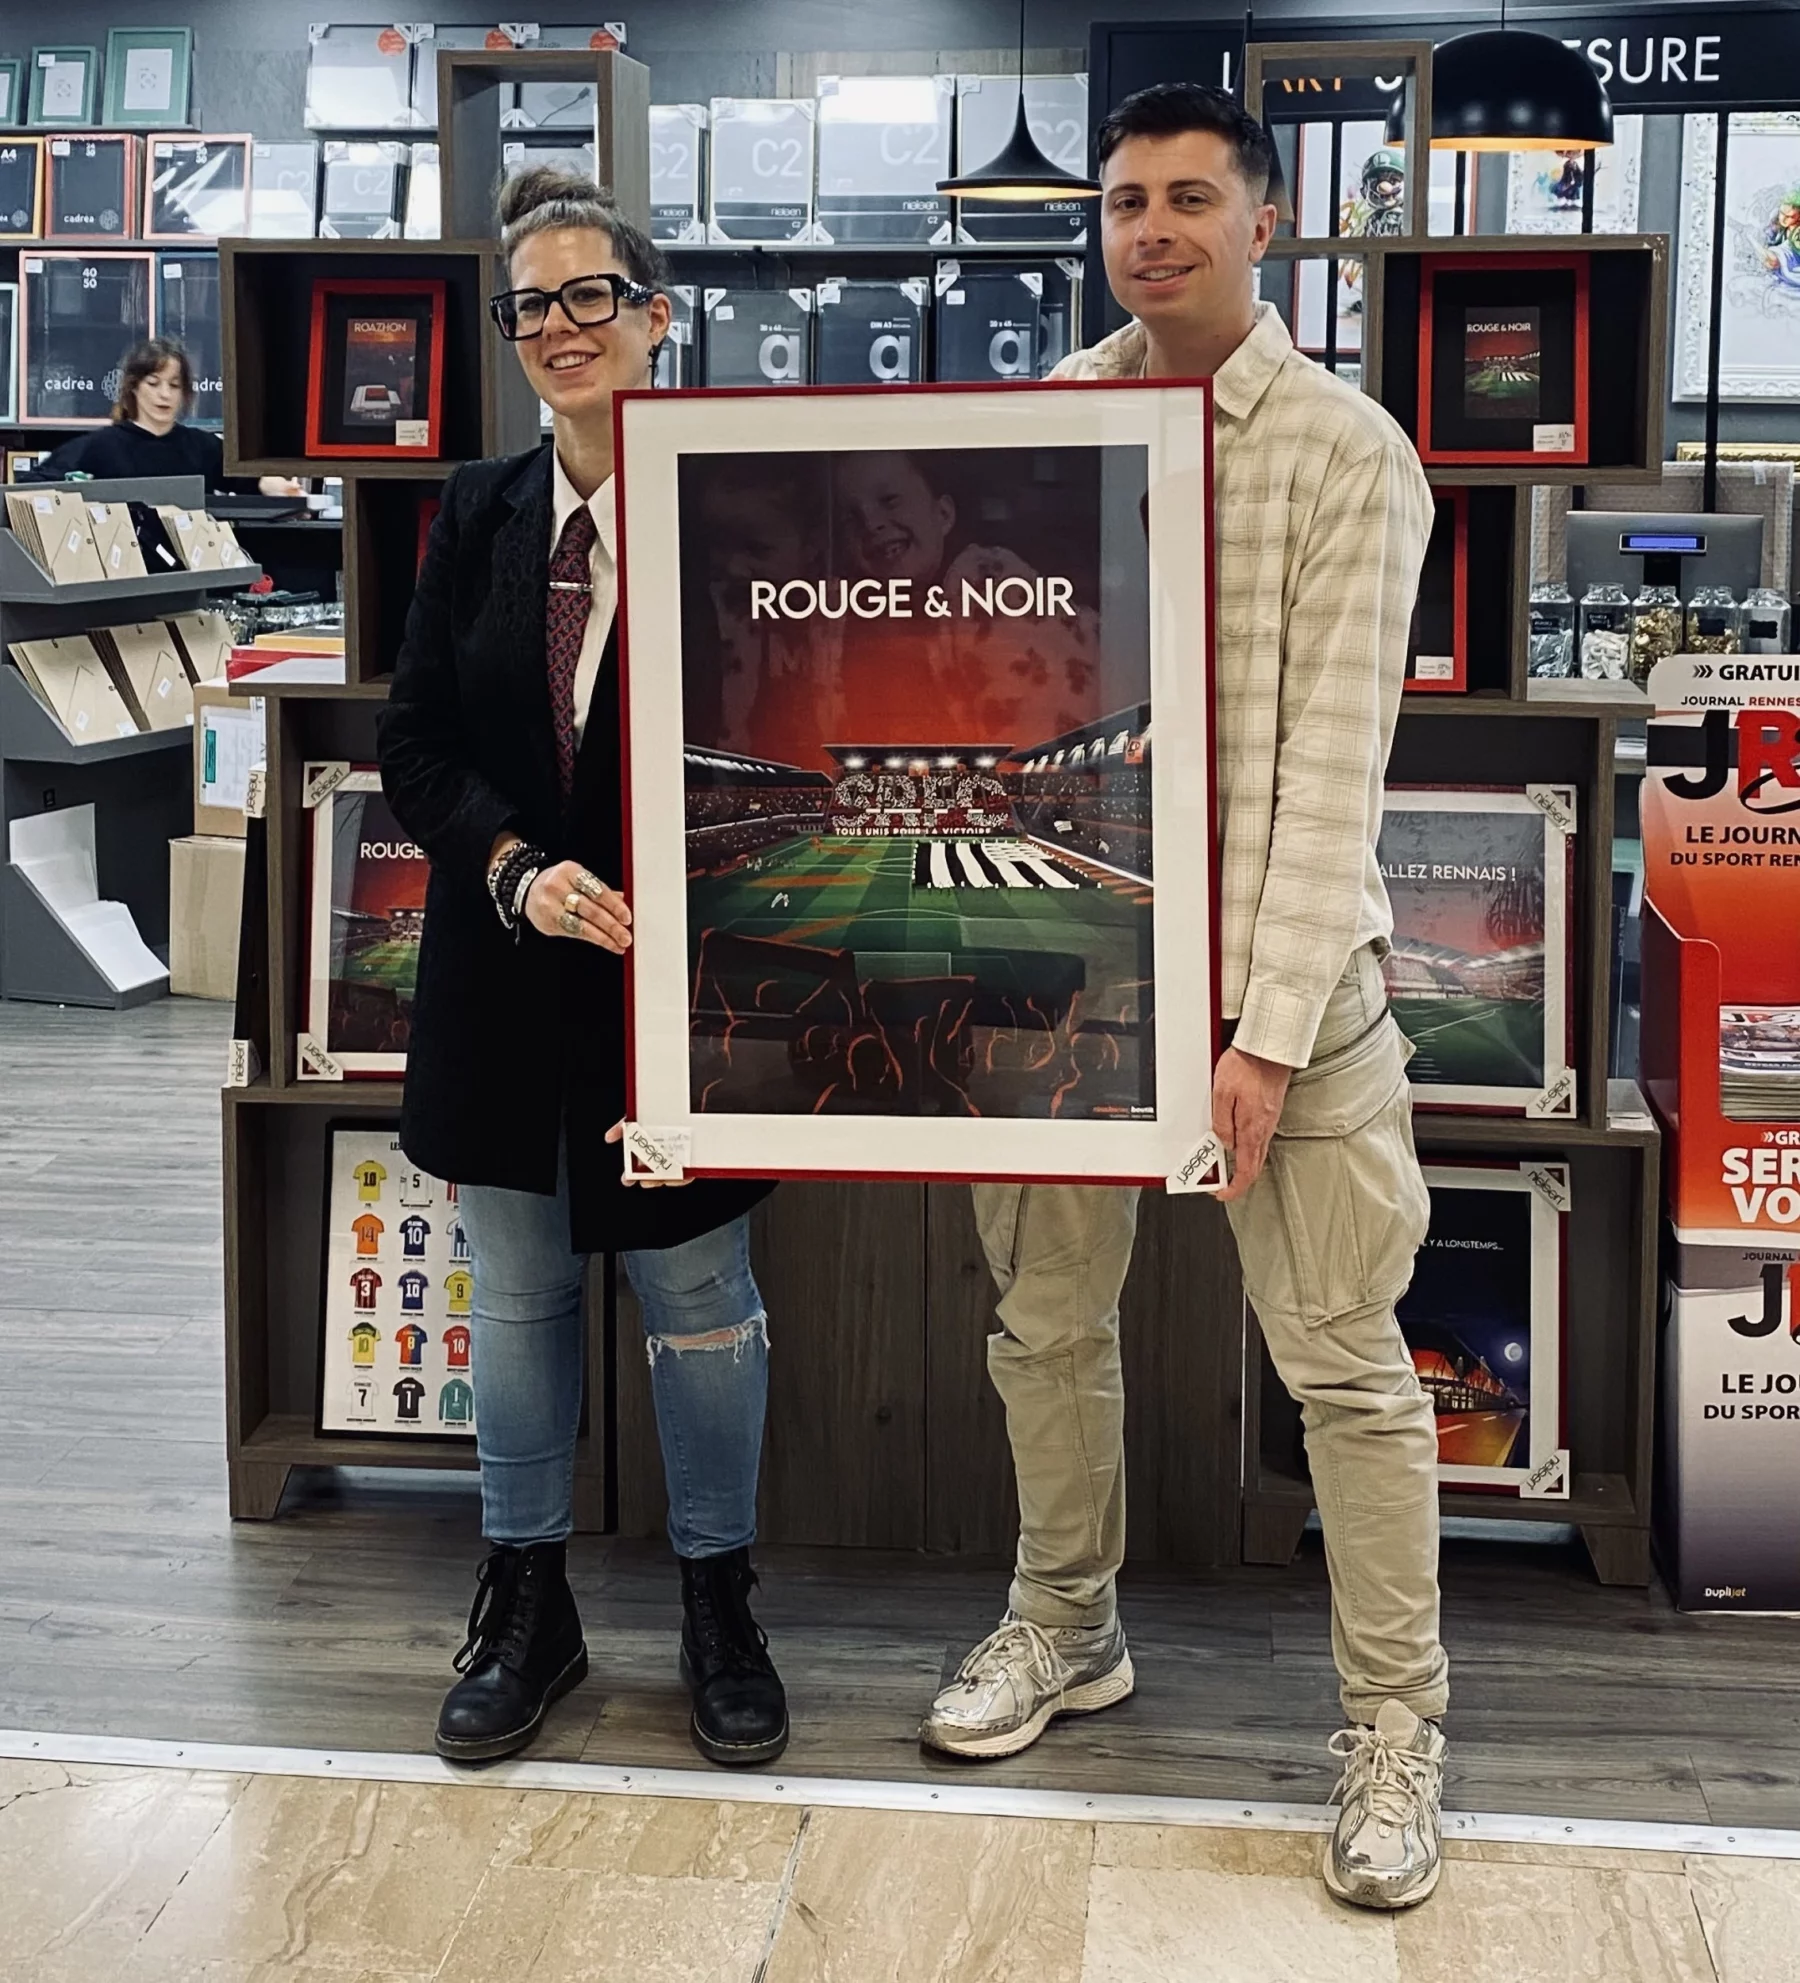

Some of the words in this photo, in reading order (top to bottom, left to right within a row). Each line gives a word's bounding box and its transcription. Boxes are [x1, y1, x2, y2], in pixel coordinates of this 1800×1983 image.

[752, 138, 803, 178] C2
[82, 267, 98, 278] 40
[82, 278, 98, 289] 50
[354, 322, 407, 333] ROAZHON
[1466, 323, 1500, 333] ROUGE
[1507, 322, 1532, 332] NOIR
[759, 333, 800, 379] a
[869, 334, 910, 379] a
[989, 330, 1031, 375] a
[750, 578, 913, 620] ROUGE
[923, 584, 951, 617] &
[961, 576, 1077, 619] NOIR
[1718, 664, 1800, 681] GRATUI
[1680, 695, 1745, 706] JOURNAL
[835, 827, 862, 836] TOUS
[865, 827, 889, 836] UNIS
[1686, 826, 1714, 843] LE
[360, 842, 425, 859] ROUGE
[1670, 852, 1698, 866] DU
[1702, 852, 1765, 867] SPORT
[1379, 864, 1428, 879] ALLEZ
[1432, 865, 1506, 881] RENNAIS
[1511, 866, 1516, 881] !
[628, 1130, 673, 1171] nielsen
[1176, 1139, 1217, 1186] nielsen
[363, 1171, 377, 1187] 10
[412, 1173, 421, 1188] 5
[1730, 1187, 1800, 1224] VO
[361, 1226, 374, 1243] 14
[407, 1227, 423, 1245] 10
[1429, 1239, 1436, 1247] Y
[1436, 1239, 1444, 1247] A
[1742, 1251, 1795, 1262] JOURNAL
[360, 1280, 371, 1297] 3
[405, 1283, 420, 1298] 10
[456, 1283, 464, 1299] 9
[452, 1337, 465, 1354] 10
[1722, 1373, 1754, 1394] LE
[1760, 1373, 1800, 1394] JO
[358, 1388, 367, 1407] 7
[405, 1390, 412, 1409] 1
[1704, 1404, 1735, 1420] DU
[1741, 1404, 1800, 1420] SPOR
